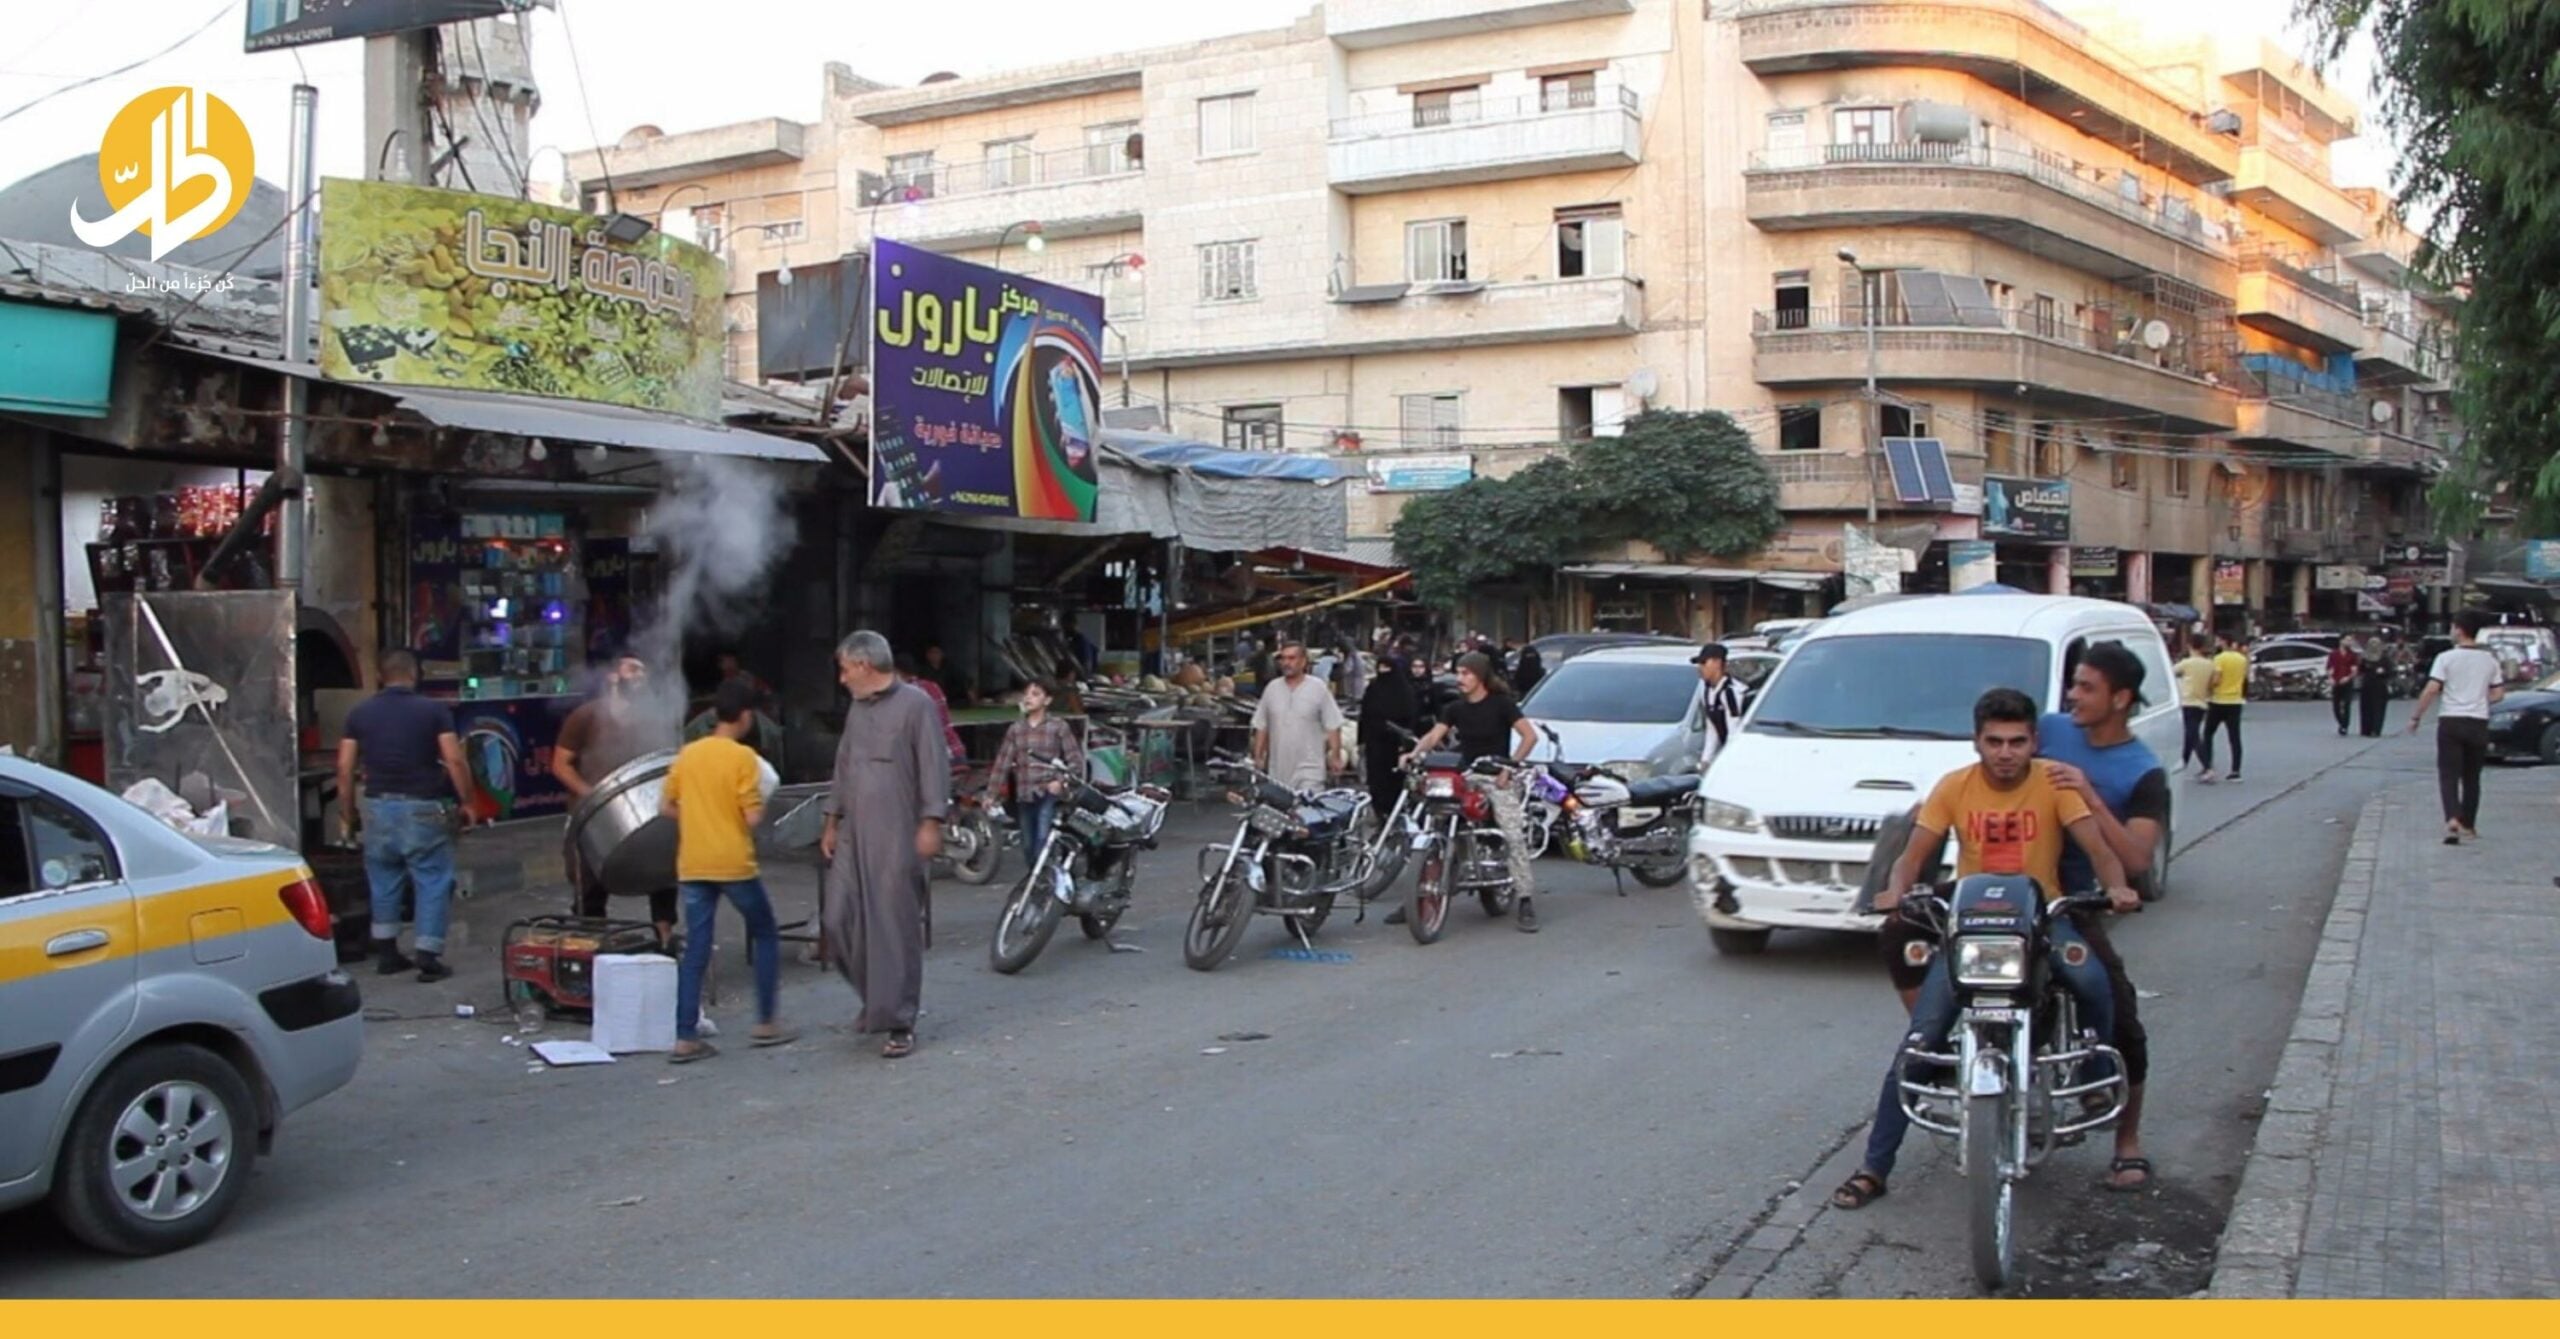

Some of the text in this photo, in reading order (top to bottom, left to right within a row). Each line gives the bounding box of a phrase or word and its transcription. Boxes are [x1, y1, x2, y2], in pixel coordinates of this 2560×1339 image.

[878, 262, 1001, 364] بارون
[999, 282, 1040, 317] مركز
[1966, 809, 2038, 843] NEED
